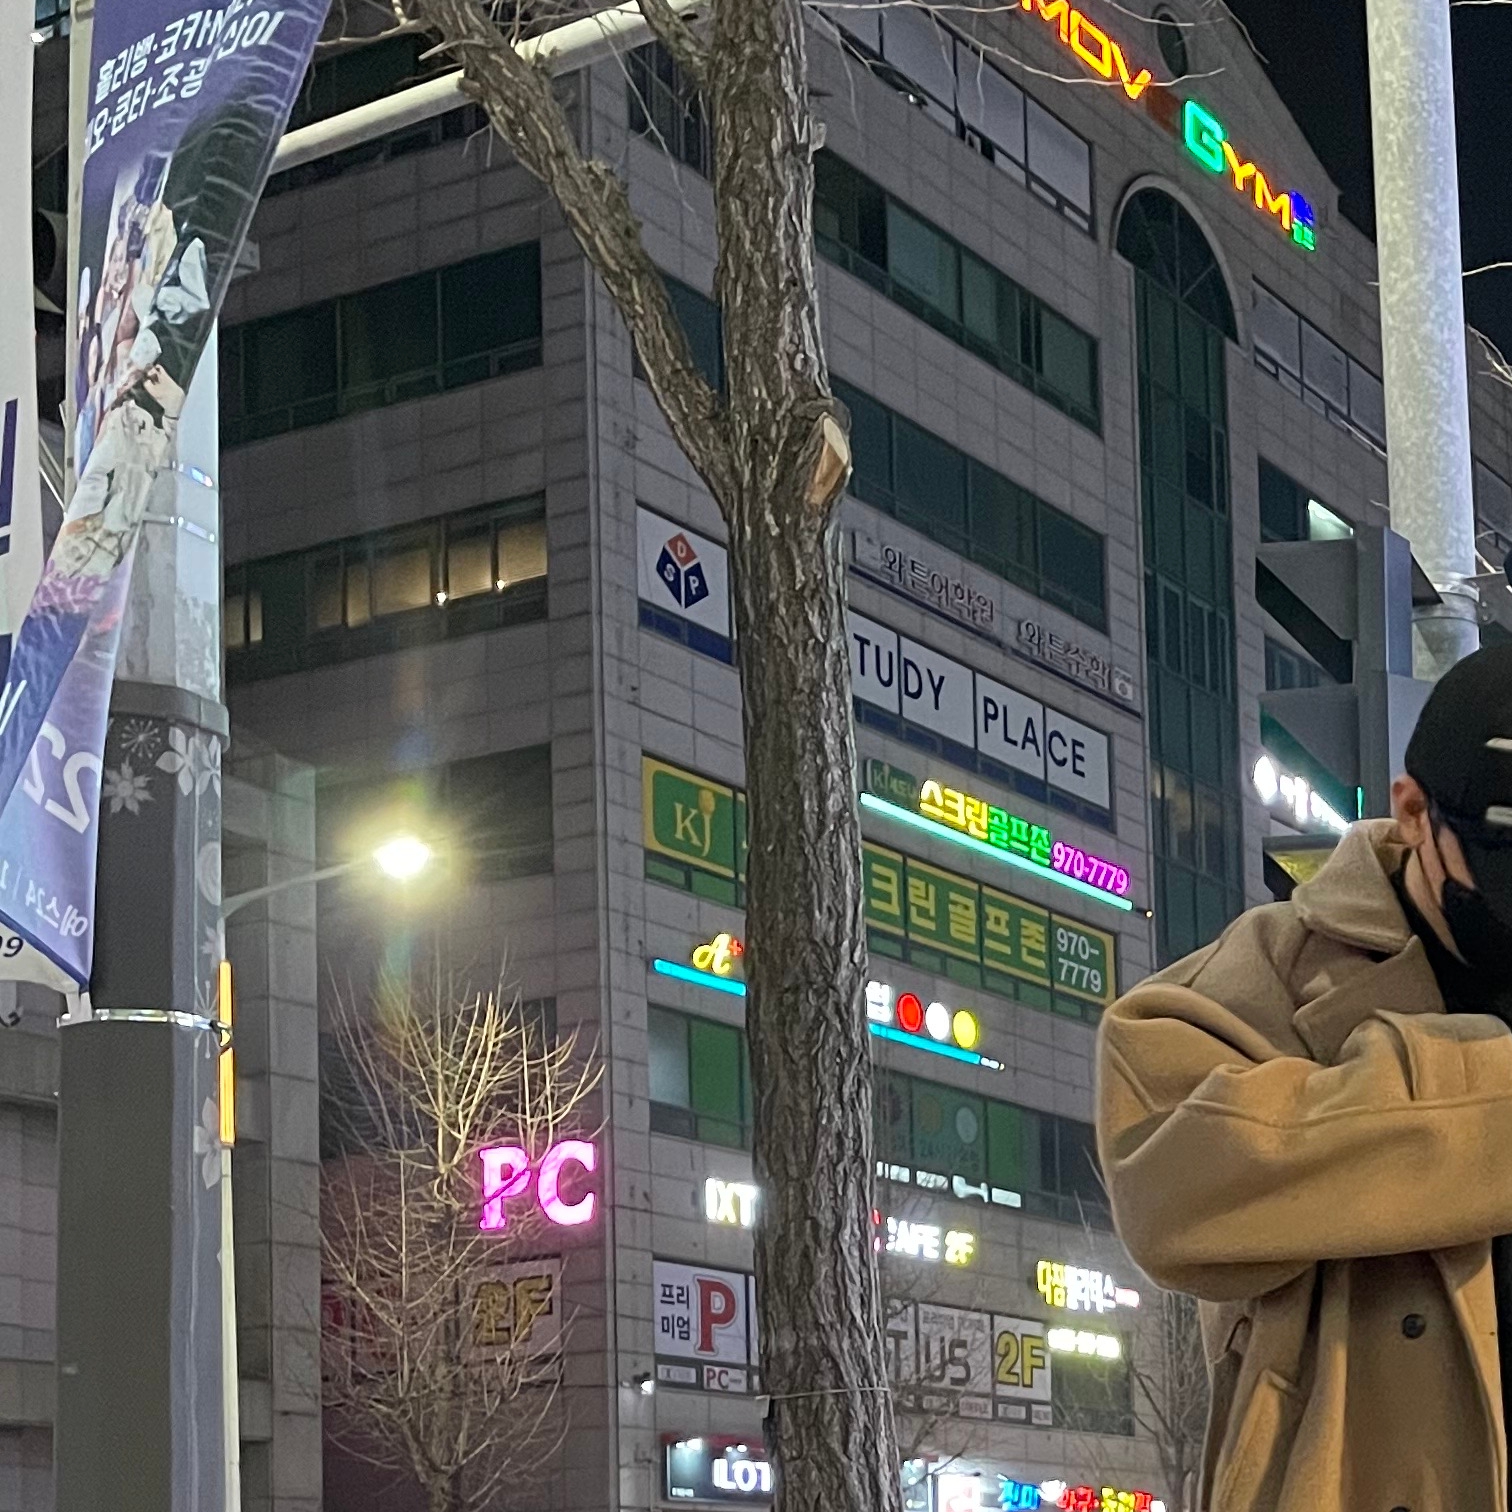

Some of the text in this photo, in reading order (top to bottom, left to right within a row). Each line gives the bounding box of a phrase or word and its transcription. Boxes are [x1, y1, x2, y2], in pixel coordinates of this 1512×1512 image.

[983, 695, 1086, 778] PLACE
[1053, 842, 1130, 895] 970-7779
[1056, 927, 1099, 960] 970-
[1058, 957, 1102, 994] 7779
[479, 1139, 596, 1230] PC
[472, 1273, 553, 1346] 2F
[660, 1283, 690, 1310] 프리
[661, 1314, 691, 1342] 미엄
[706, 1367, 729, 1390] PC
[996, 1330, 1046, 1389] 2F
